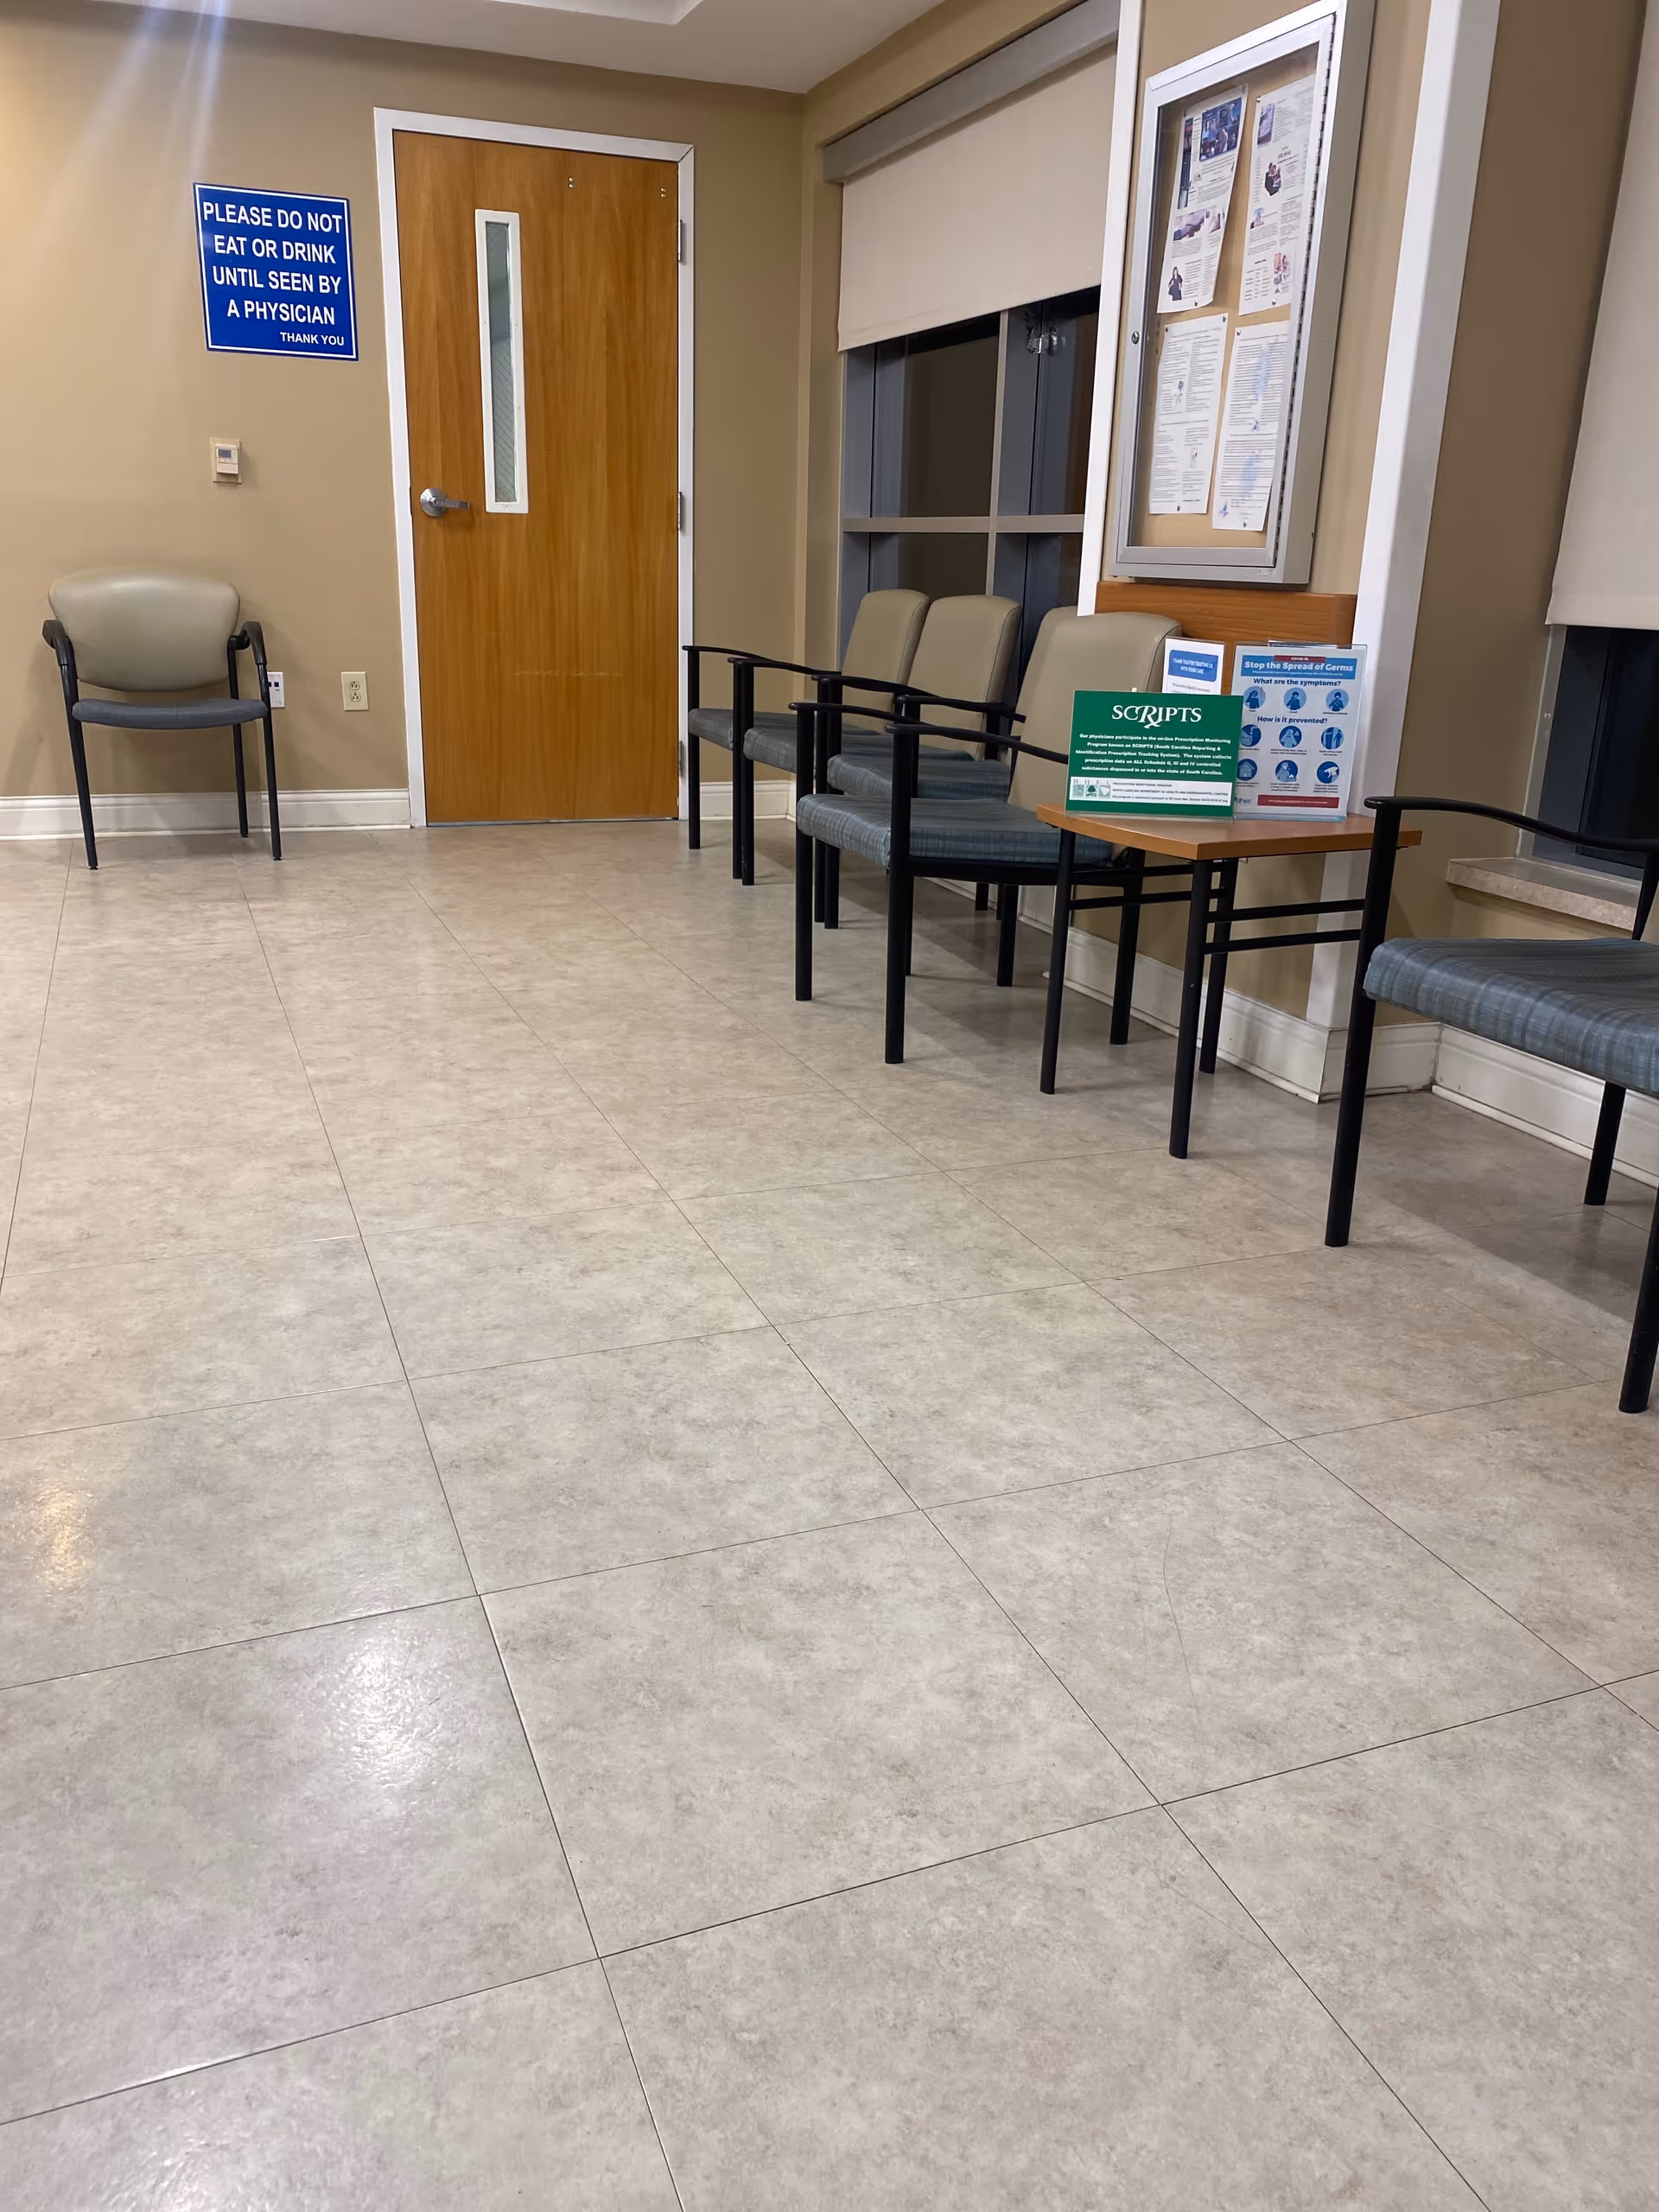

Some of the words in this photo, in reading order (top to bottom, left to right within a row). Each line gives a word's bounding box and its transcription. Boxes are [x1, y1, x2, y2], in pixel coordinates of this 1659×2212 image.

[203, 201, 273, 227] PLEASE
[277, 209, 302, 229] DO
[308, 212, 343, 233] NOT
[214, 235, 247, 255] EAT
[252, 238, 278, 258] OR
[283, 241, 336, 264] DRINK
[213, 266, 264, 288] UNTIL
[268, 271, 314, 292] SEEN
[319, 276, 341, 294] BY
[227, 299, 240, 318] A
[244, 300, 335, 325] PHYSICIAN
[280, 332, 318, 344] THANK
[321, 335, 344, 346] YOU
[1245, 661, 1265, 670] Stop
[1282, 662, 1313, 671] Spread
[1112, 705, 1202, 728] SCRIPTS
